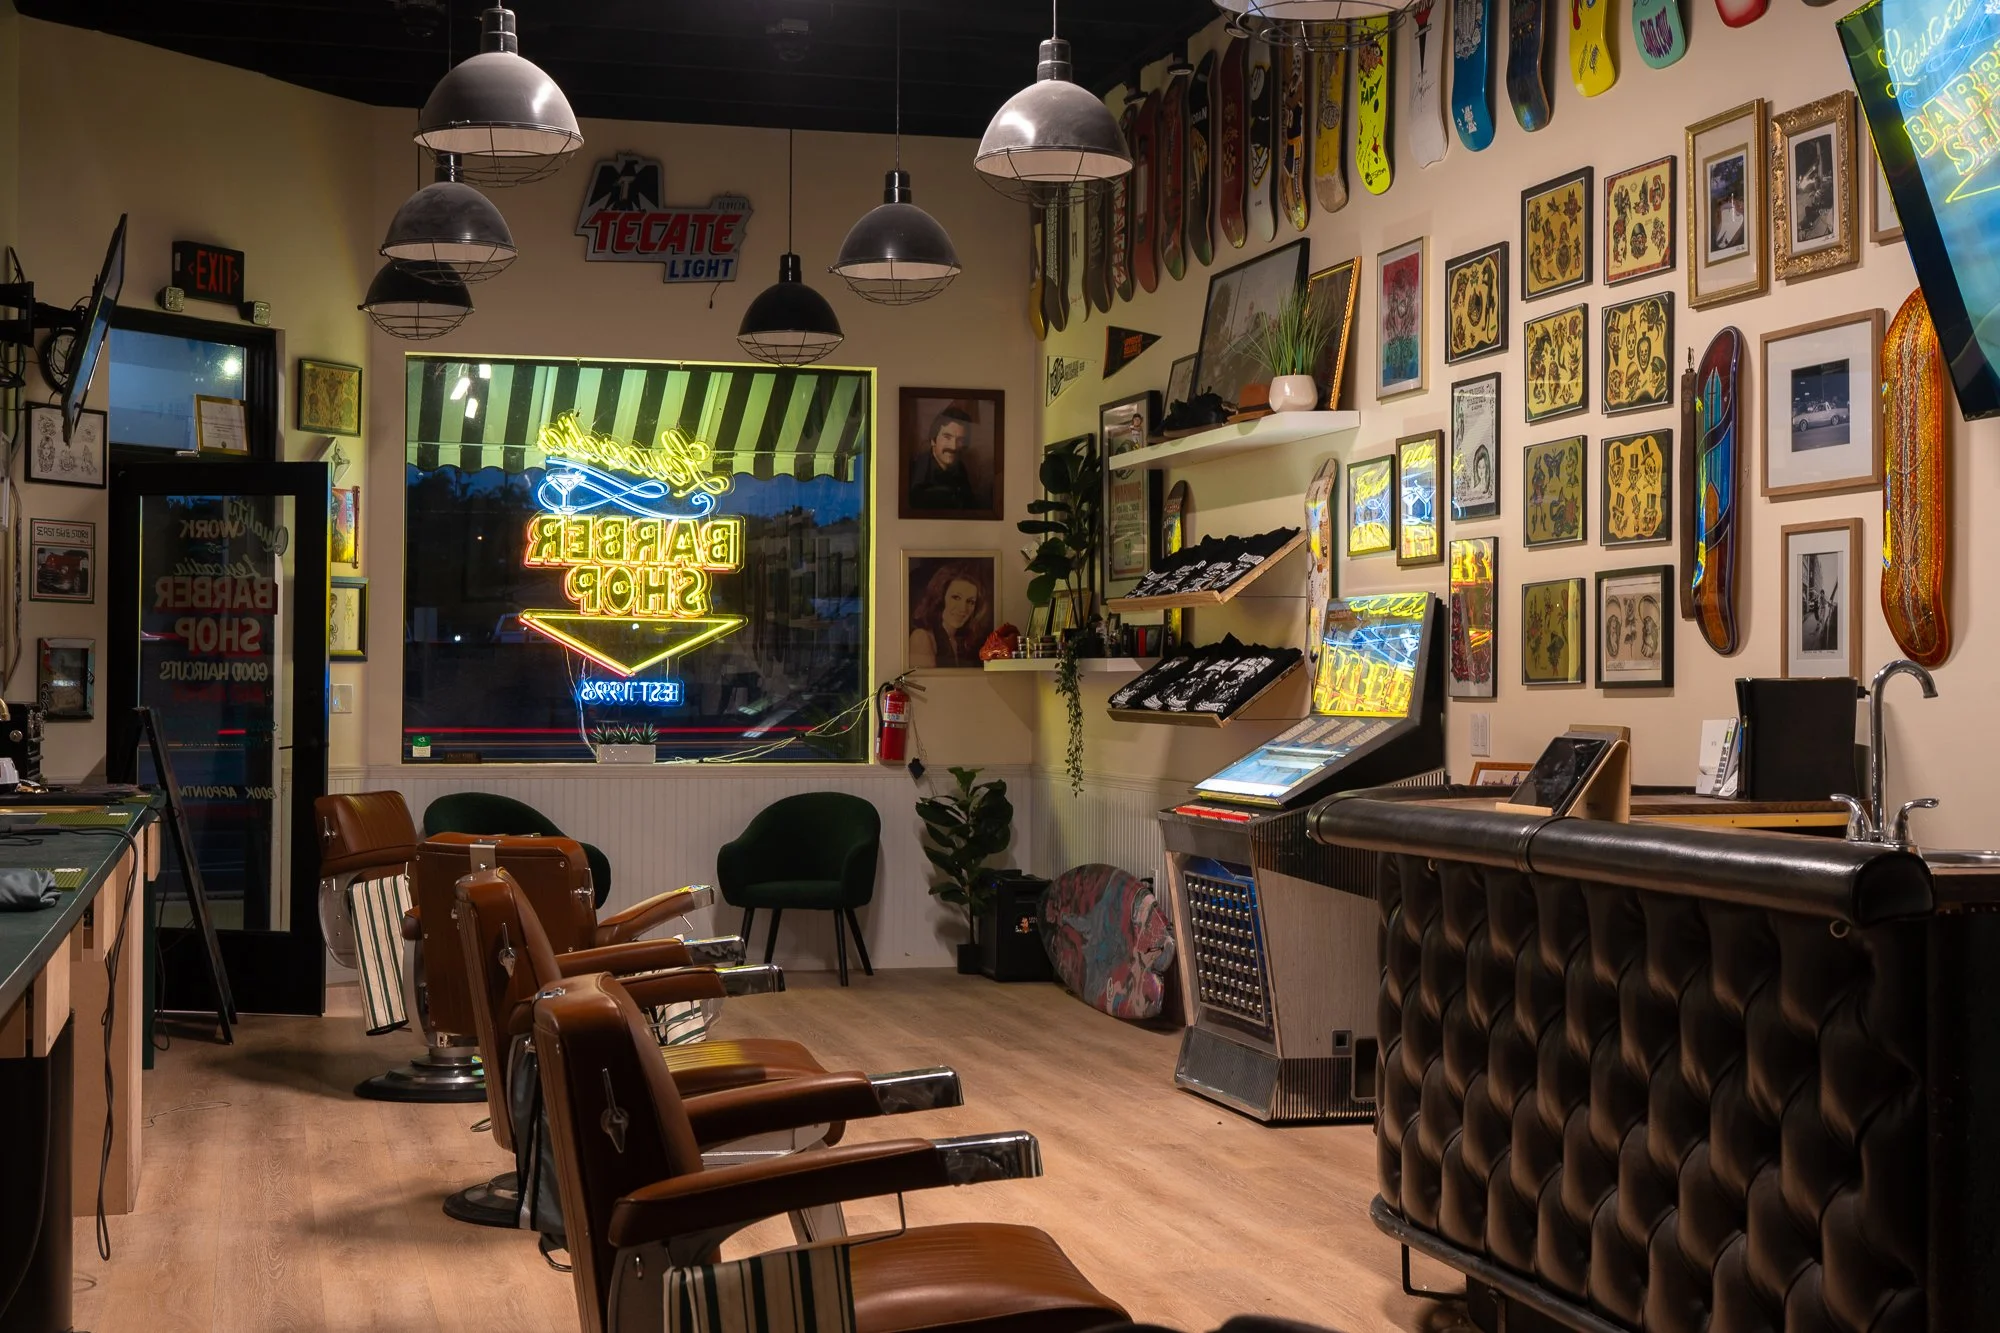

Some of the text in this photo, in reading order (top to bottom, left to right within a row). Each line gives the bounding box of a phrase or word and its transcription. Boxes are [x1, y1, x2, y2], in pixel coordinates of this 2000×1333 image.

[585, 211, 743, 255] TECATE
[196, 249, 235, 295] EXIT
[669, 258, 734, 279] LIGHT
